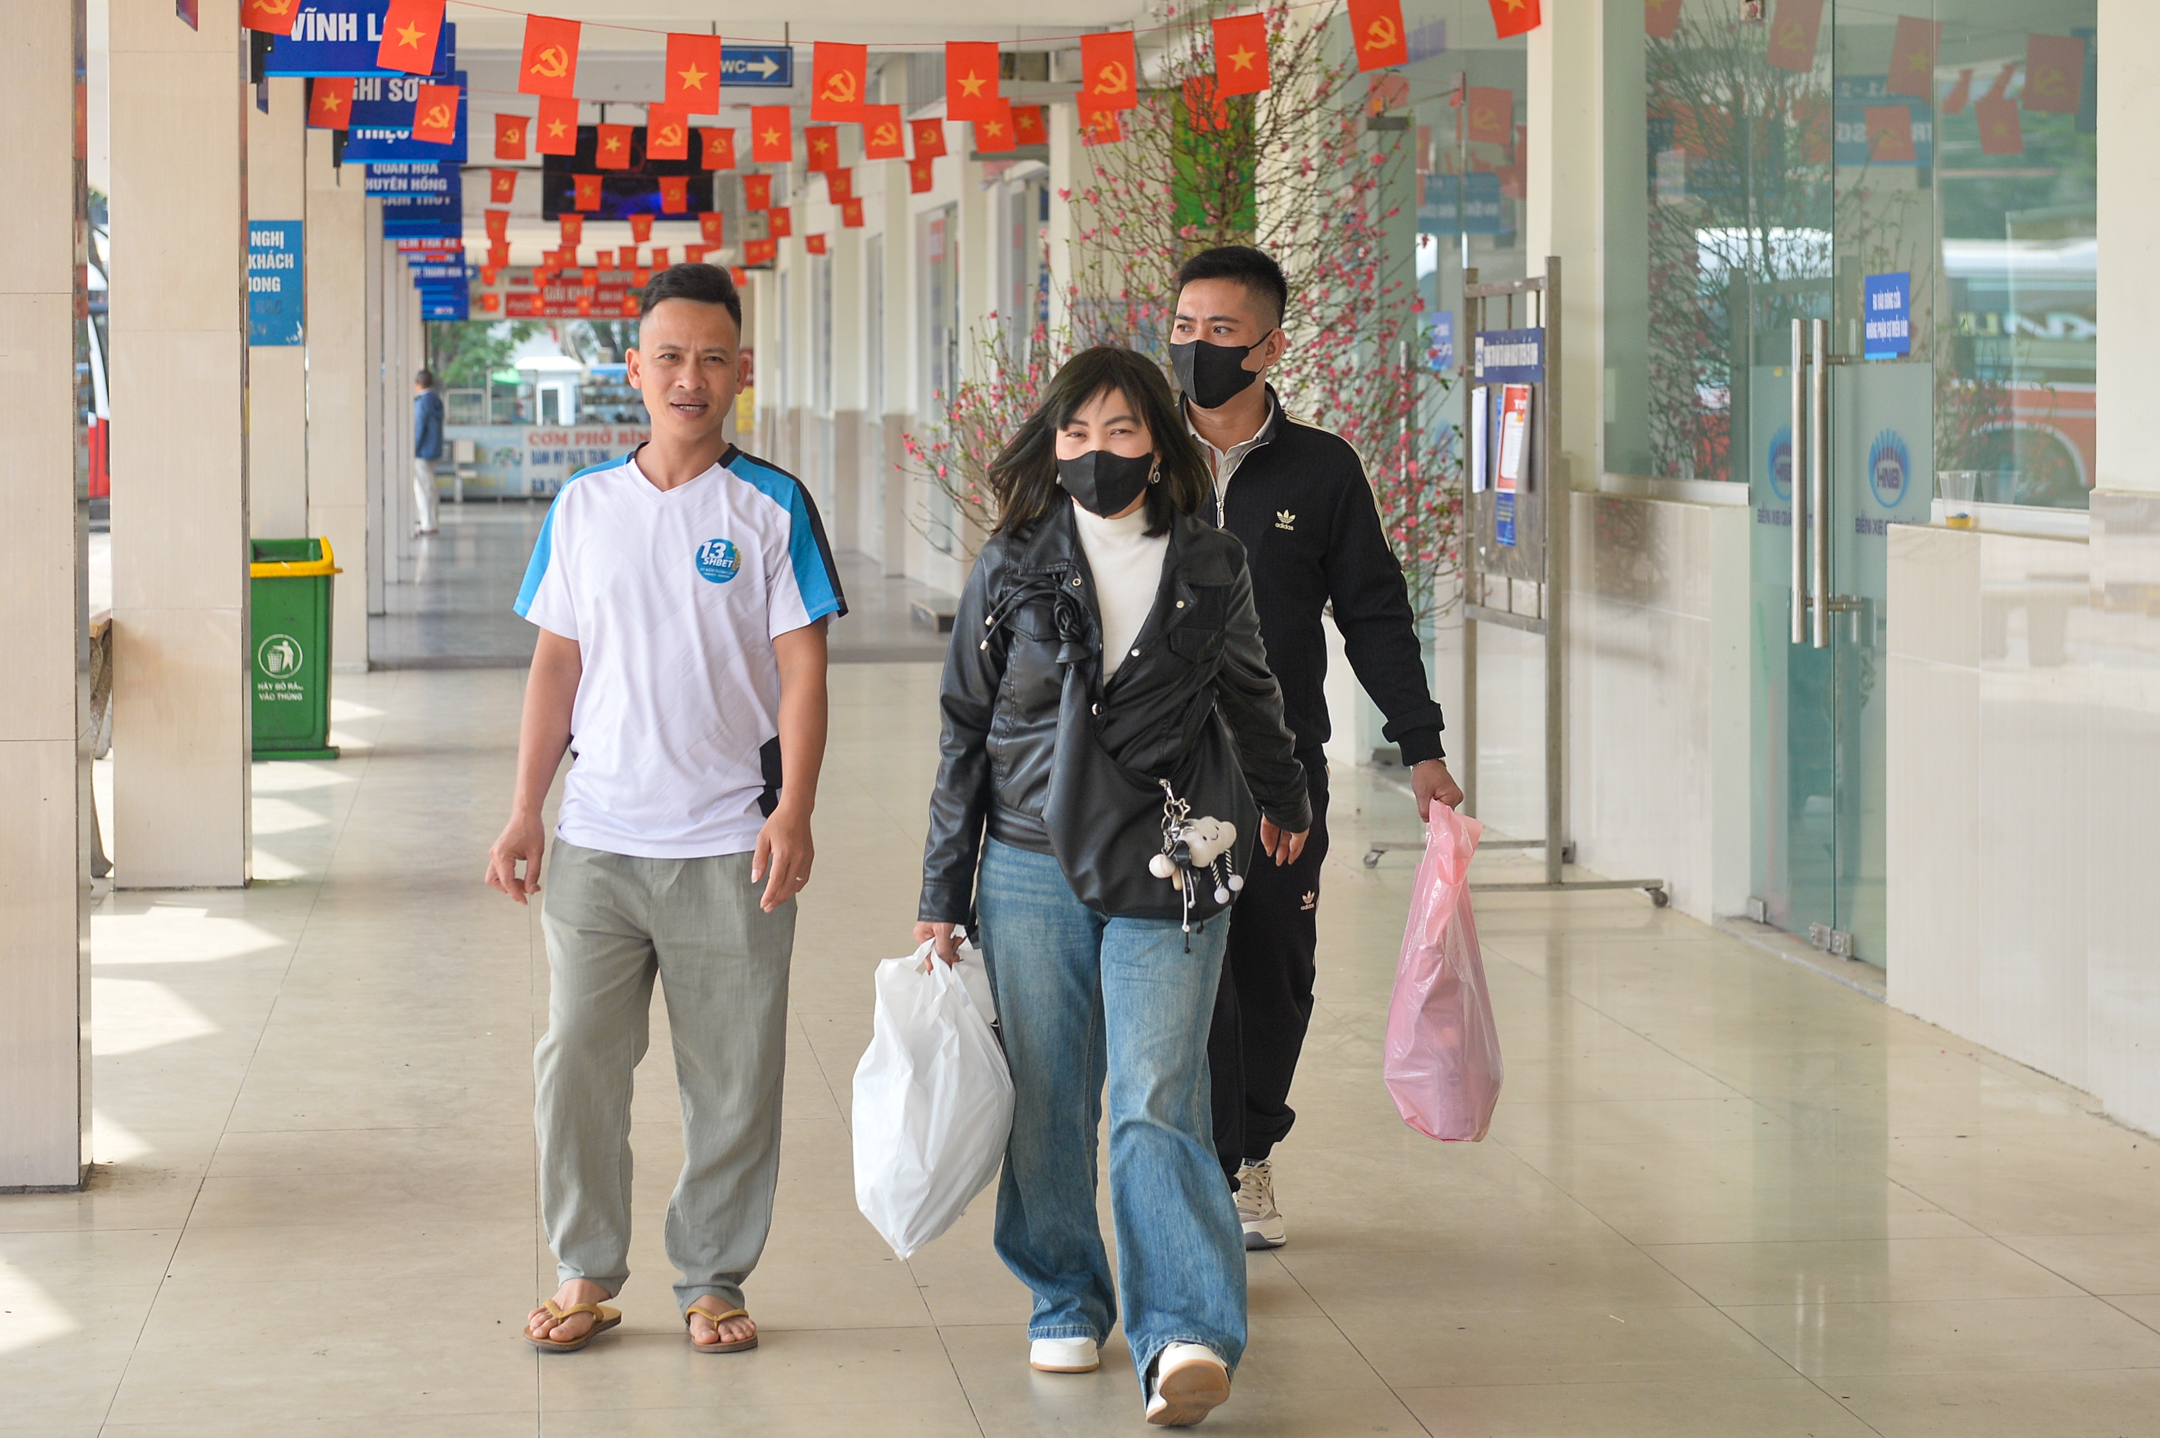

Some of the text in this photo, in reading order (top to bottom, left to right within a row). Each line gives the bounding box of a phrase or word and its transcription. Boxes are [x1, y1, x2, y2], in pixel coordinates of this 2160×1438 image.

[290, 7, 357, 42] VĨNH
[721, 60, 746, 74] WC
[251, 231, 284, 249] NGHỊ
[248, 250, 294, 269] KHÁCH
[701, 541, 727, 559] 13
